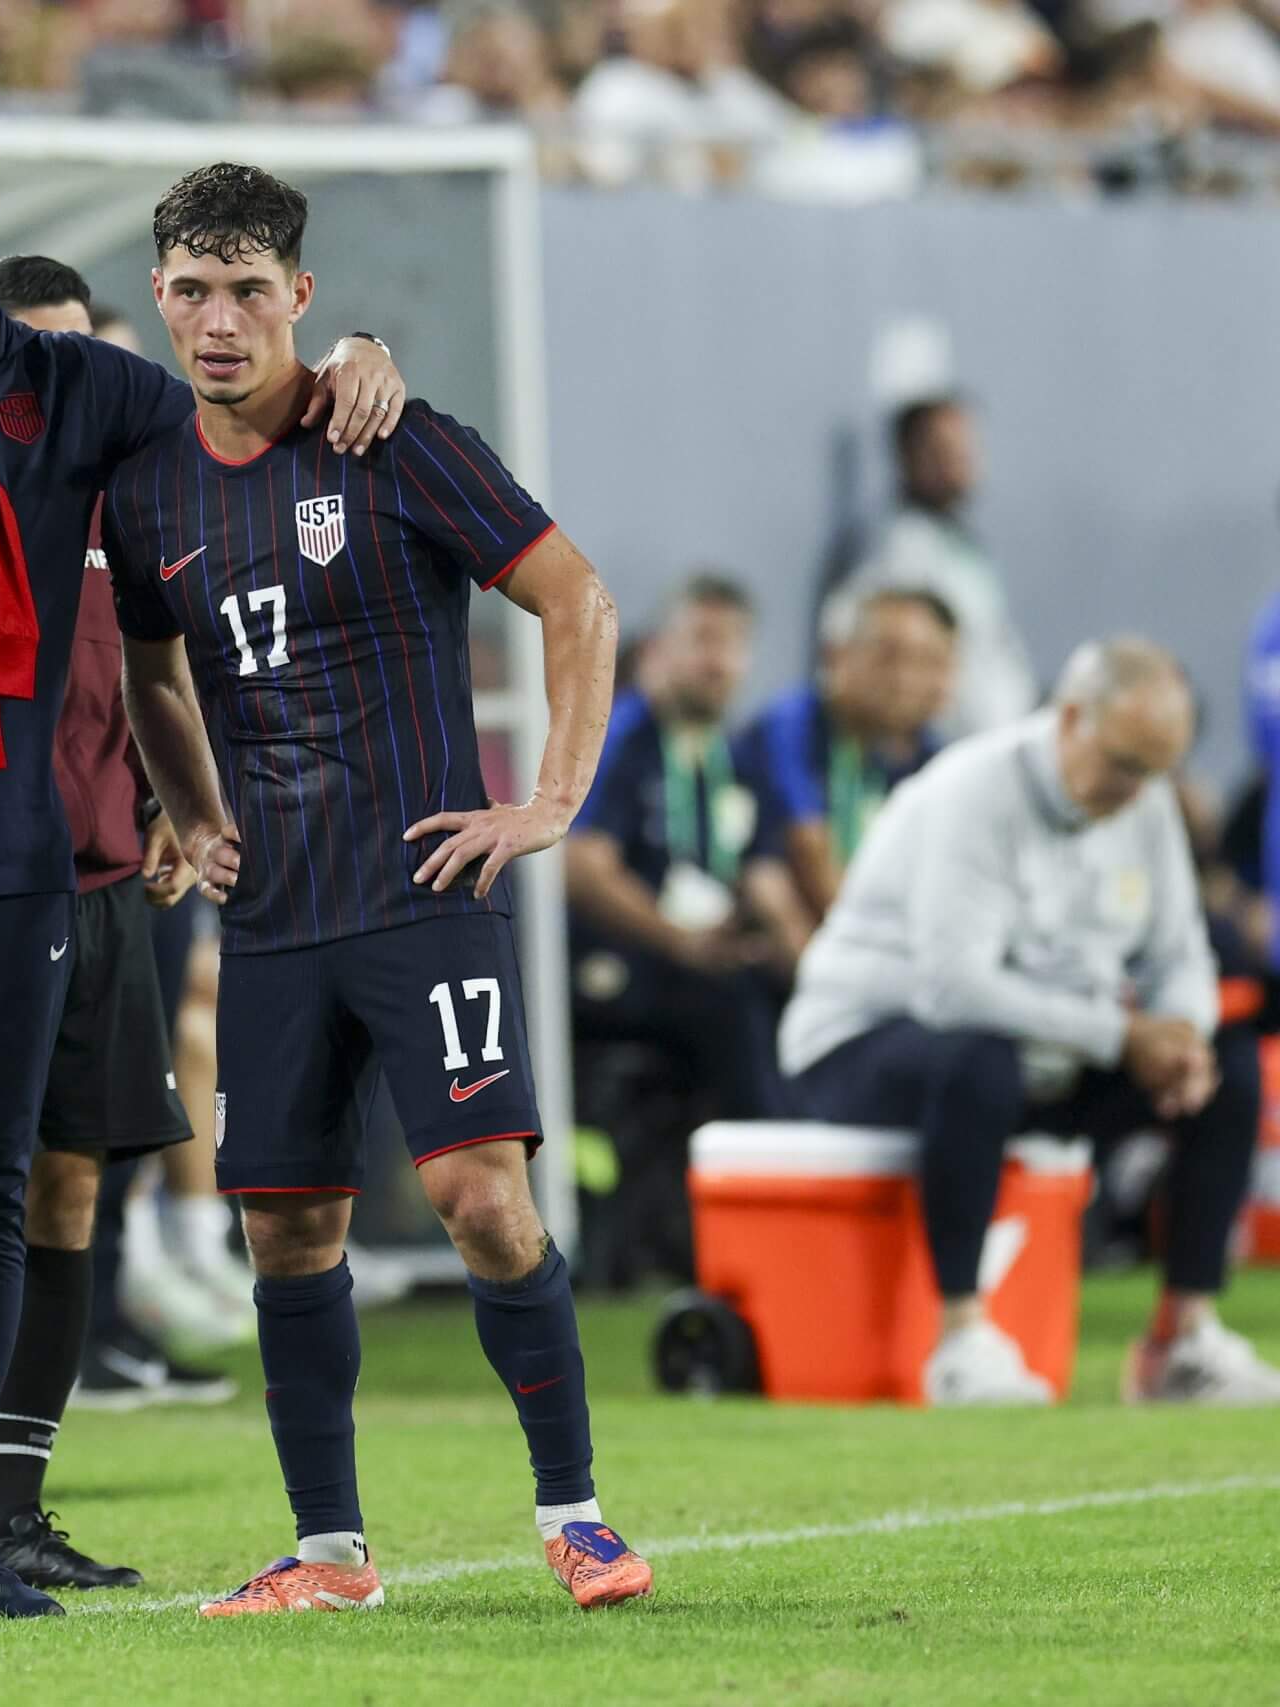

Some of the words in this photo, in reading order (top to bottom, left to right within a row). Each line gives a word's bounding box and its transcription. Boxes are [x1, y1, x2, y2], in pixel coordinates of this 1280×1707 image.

[299, 498, 340, 526] USA
[219, 584, 291, 677] 17
[428, 977, 504, 1071] 17
